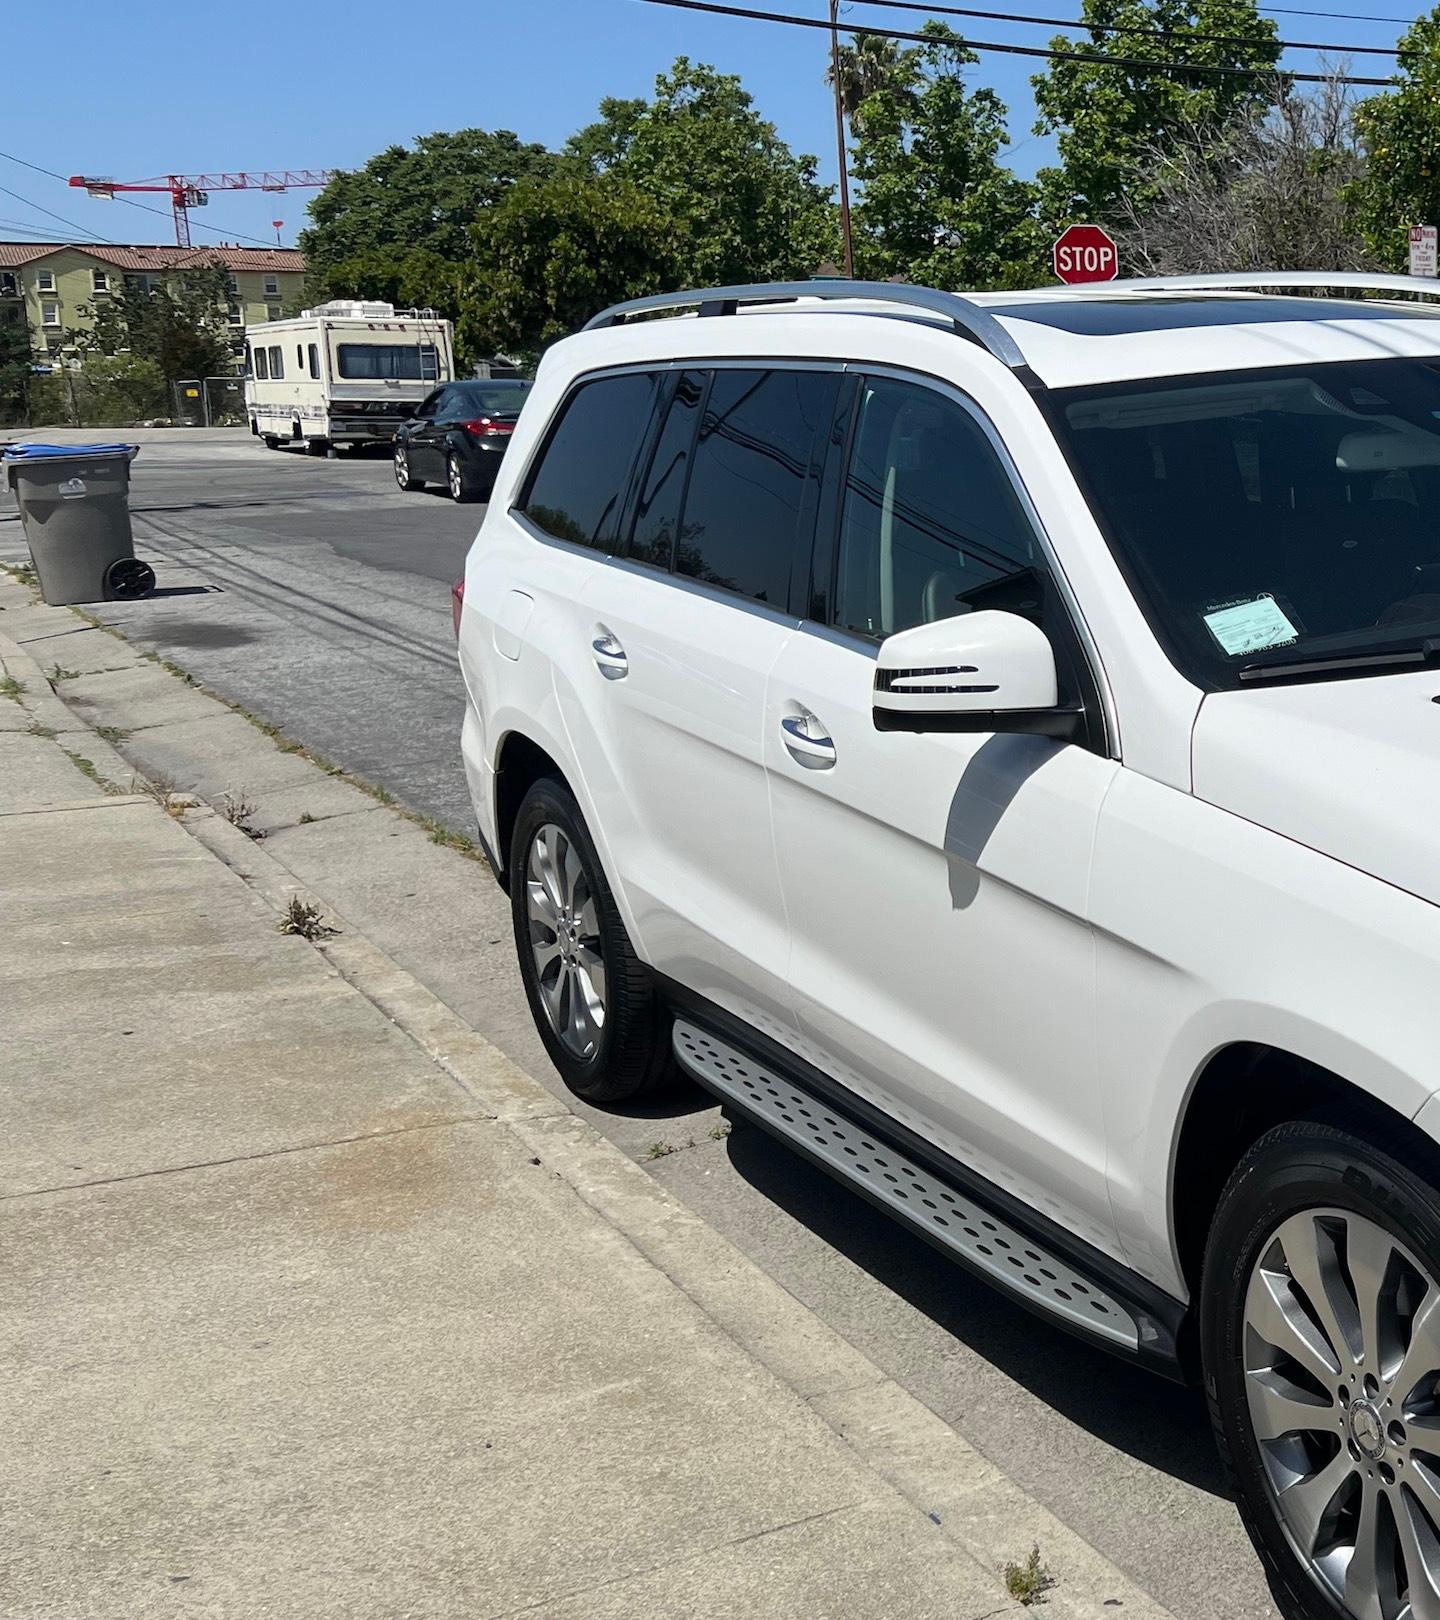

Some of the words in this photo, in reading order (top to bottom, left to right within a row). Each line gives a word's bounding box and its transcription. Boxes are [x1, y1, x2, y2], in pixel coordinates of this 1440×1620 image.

[1411, 228, 1421, 241] NO
[1059, 246, 1113, 272] STOP
[1206, 598, 1252, 611] Mercedes-Benz
